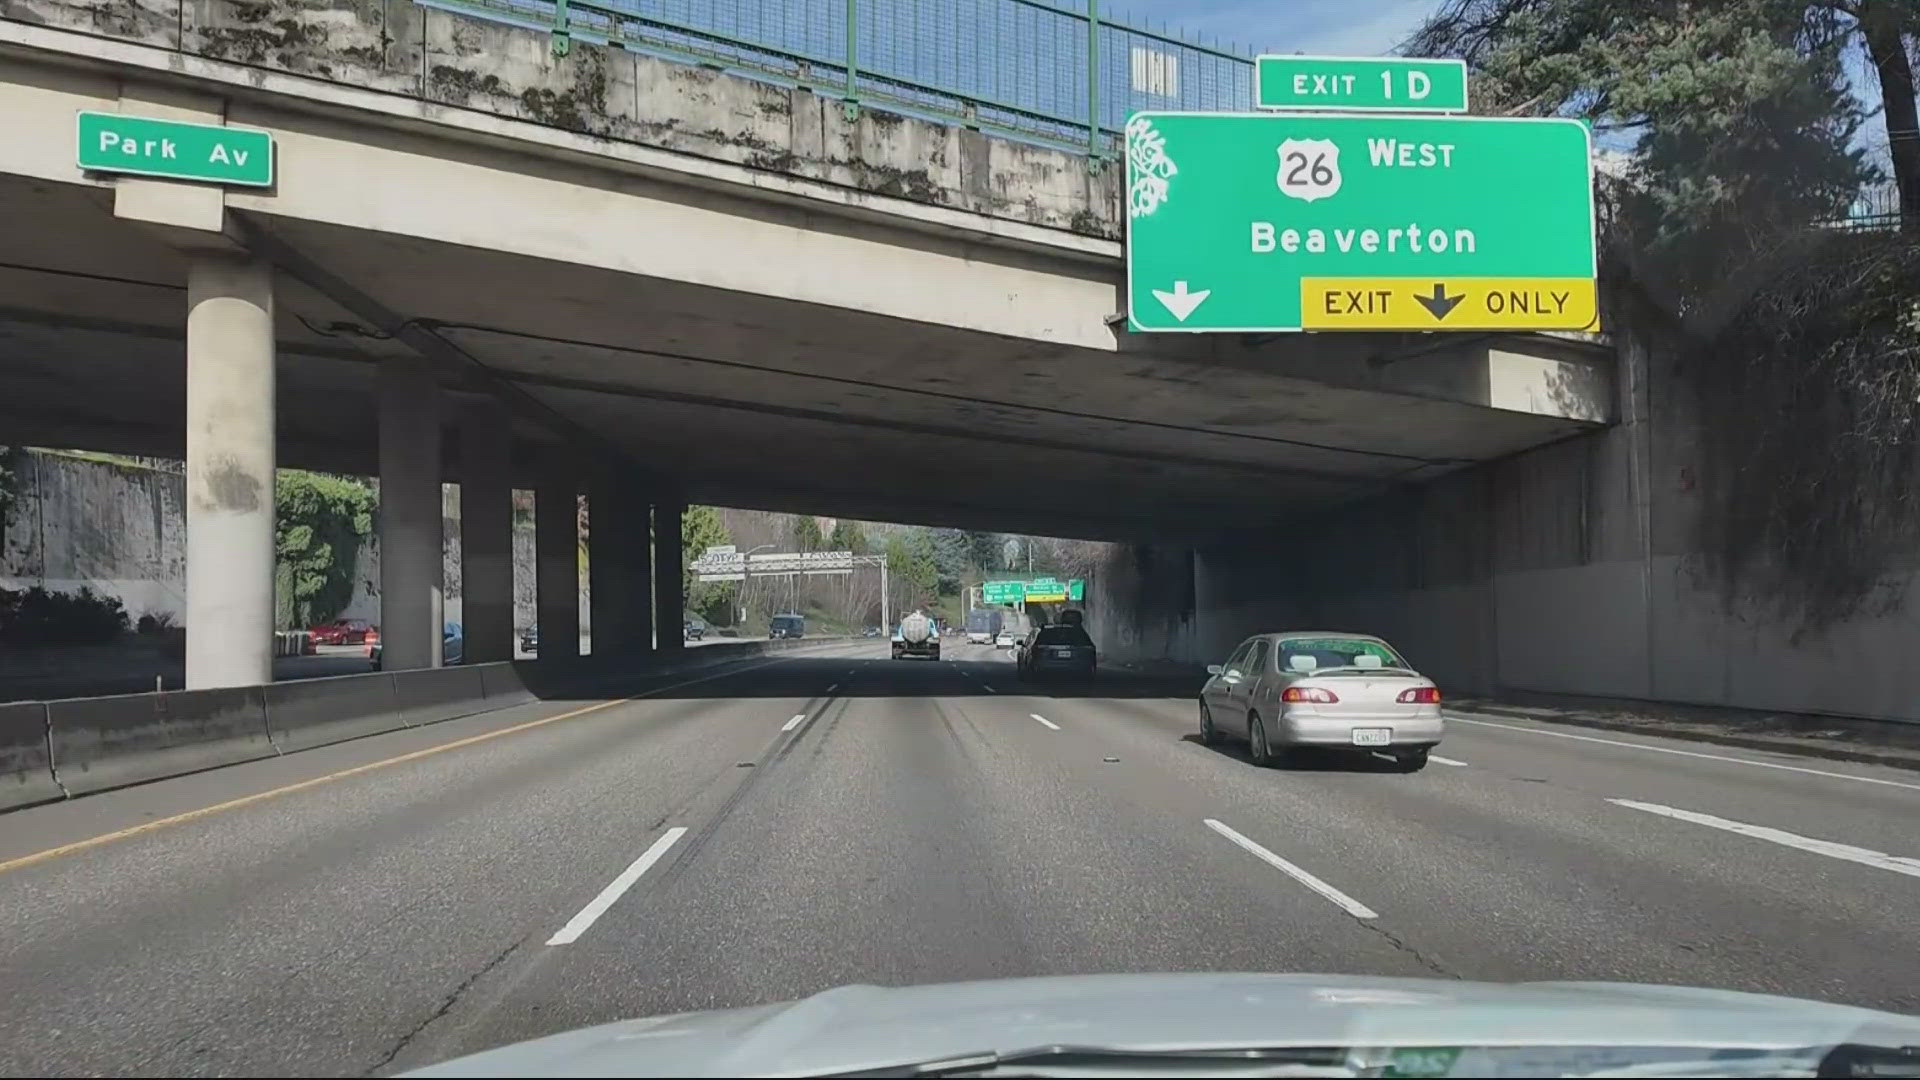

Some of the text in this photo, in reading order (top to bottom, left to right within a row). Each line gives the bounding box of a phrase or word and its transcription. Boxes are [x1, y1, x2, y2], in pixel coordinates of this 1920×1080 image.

[1293, 74, 1356, 95] EXIT
[99, 131, 248, 166] Park Av
[1367, 138, 1455, 168] WEST
[1285, 152, 1333, 186] 26
[1251, 222, 1476, 253] Beaverton
[1325, 291, 1570, 315] EXIT ONLY
